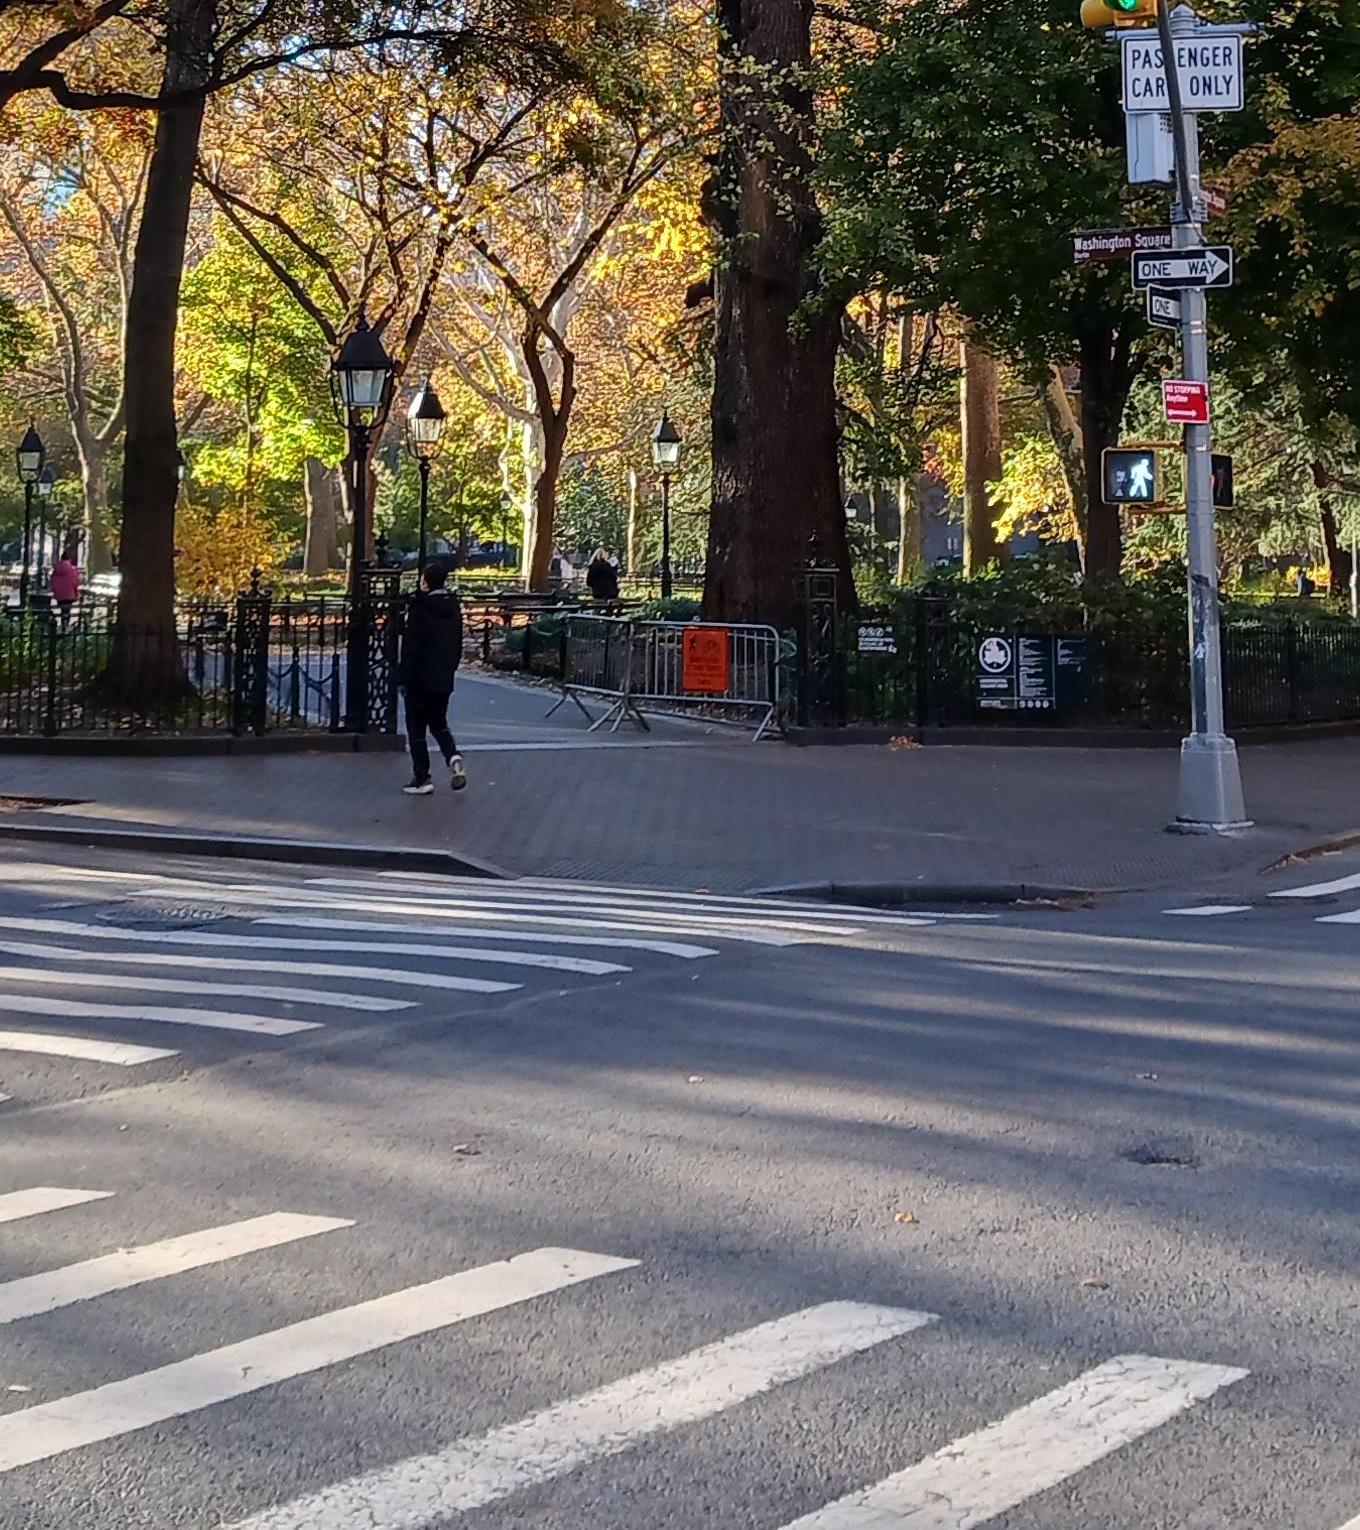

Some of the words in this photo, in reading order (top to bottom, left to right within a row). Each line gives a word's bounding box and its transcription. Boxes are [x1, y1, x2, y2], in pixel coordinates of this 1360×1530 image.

[1131, 46, 1233, 70] PASENGER
[1190, 75, 1233, 96] ONLY
[1074, 235, 1131, 253] Washington
[1135, 233, 1171, 249] Square
[1142, 262, 1171, 277] ONE
[1188, 260, 1218, 276] WAY
[1154, 299, 1170, 315] ONE
